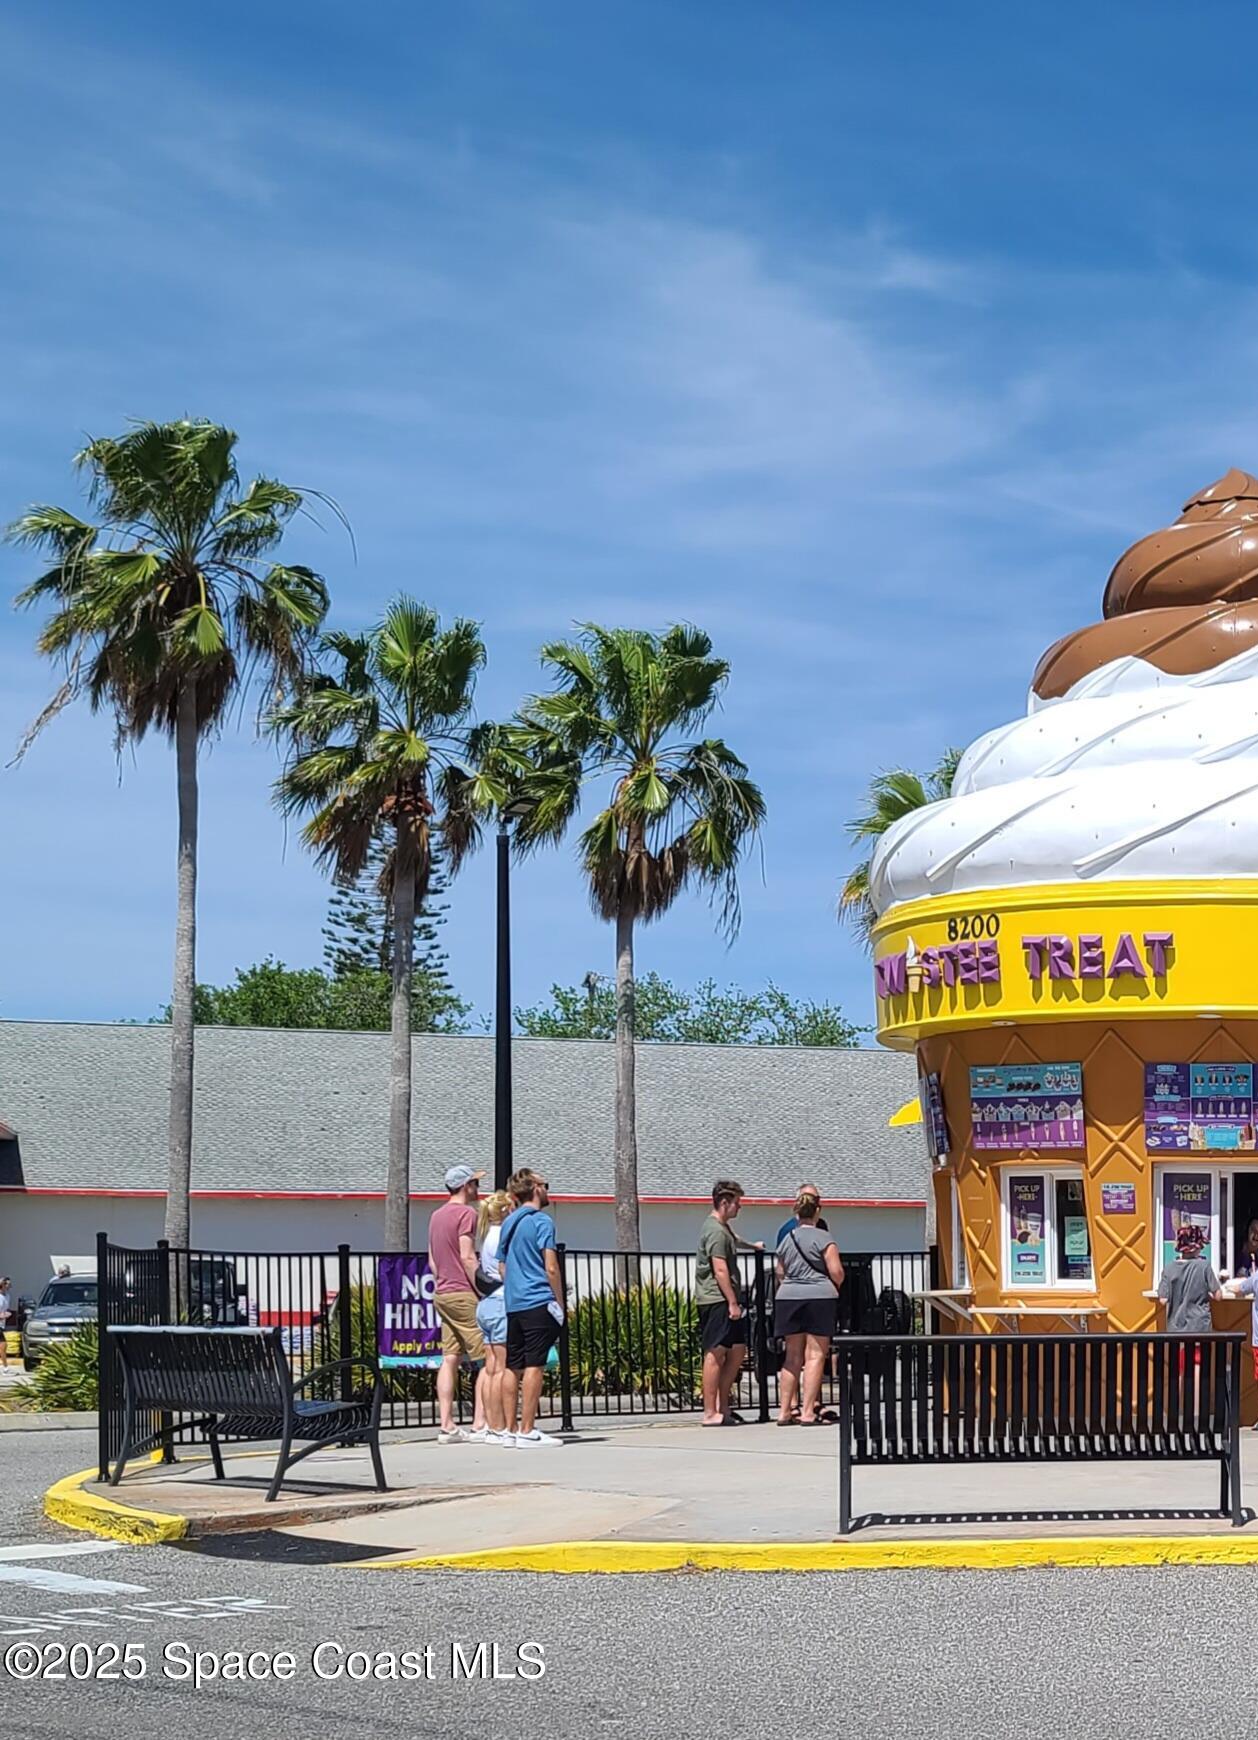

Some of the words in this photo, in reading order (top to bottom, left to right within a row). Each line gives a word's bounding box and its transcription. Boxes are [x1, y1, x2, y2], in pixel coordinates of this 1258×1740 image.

[948, 914, 1000, 941] 8200
[1022, 934, 1174, 979] TREAT
[1014, 1185, 1029, 1193] PICK
[1173, 1184, 1193, 1193] PICK
[1196, 1184, 1209, 1193] UP
[401, 1273, 436, 1301] NO
[384, 1303, 442, 1329] HIRI
[392, 1339, 422, 1354] Apply
